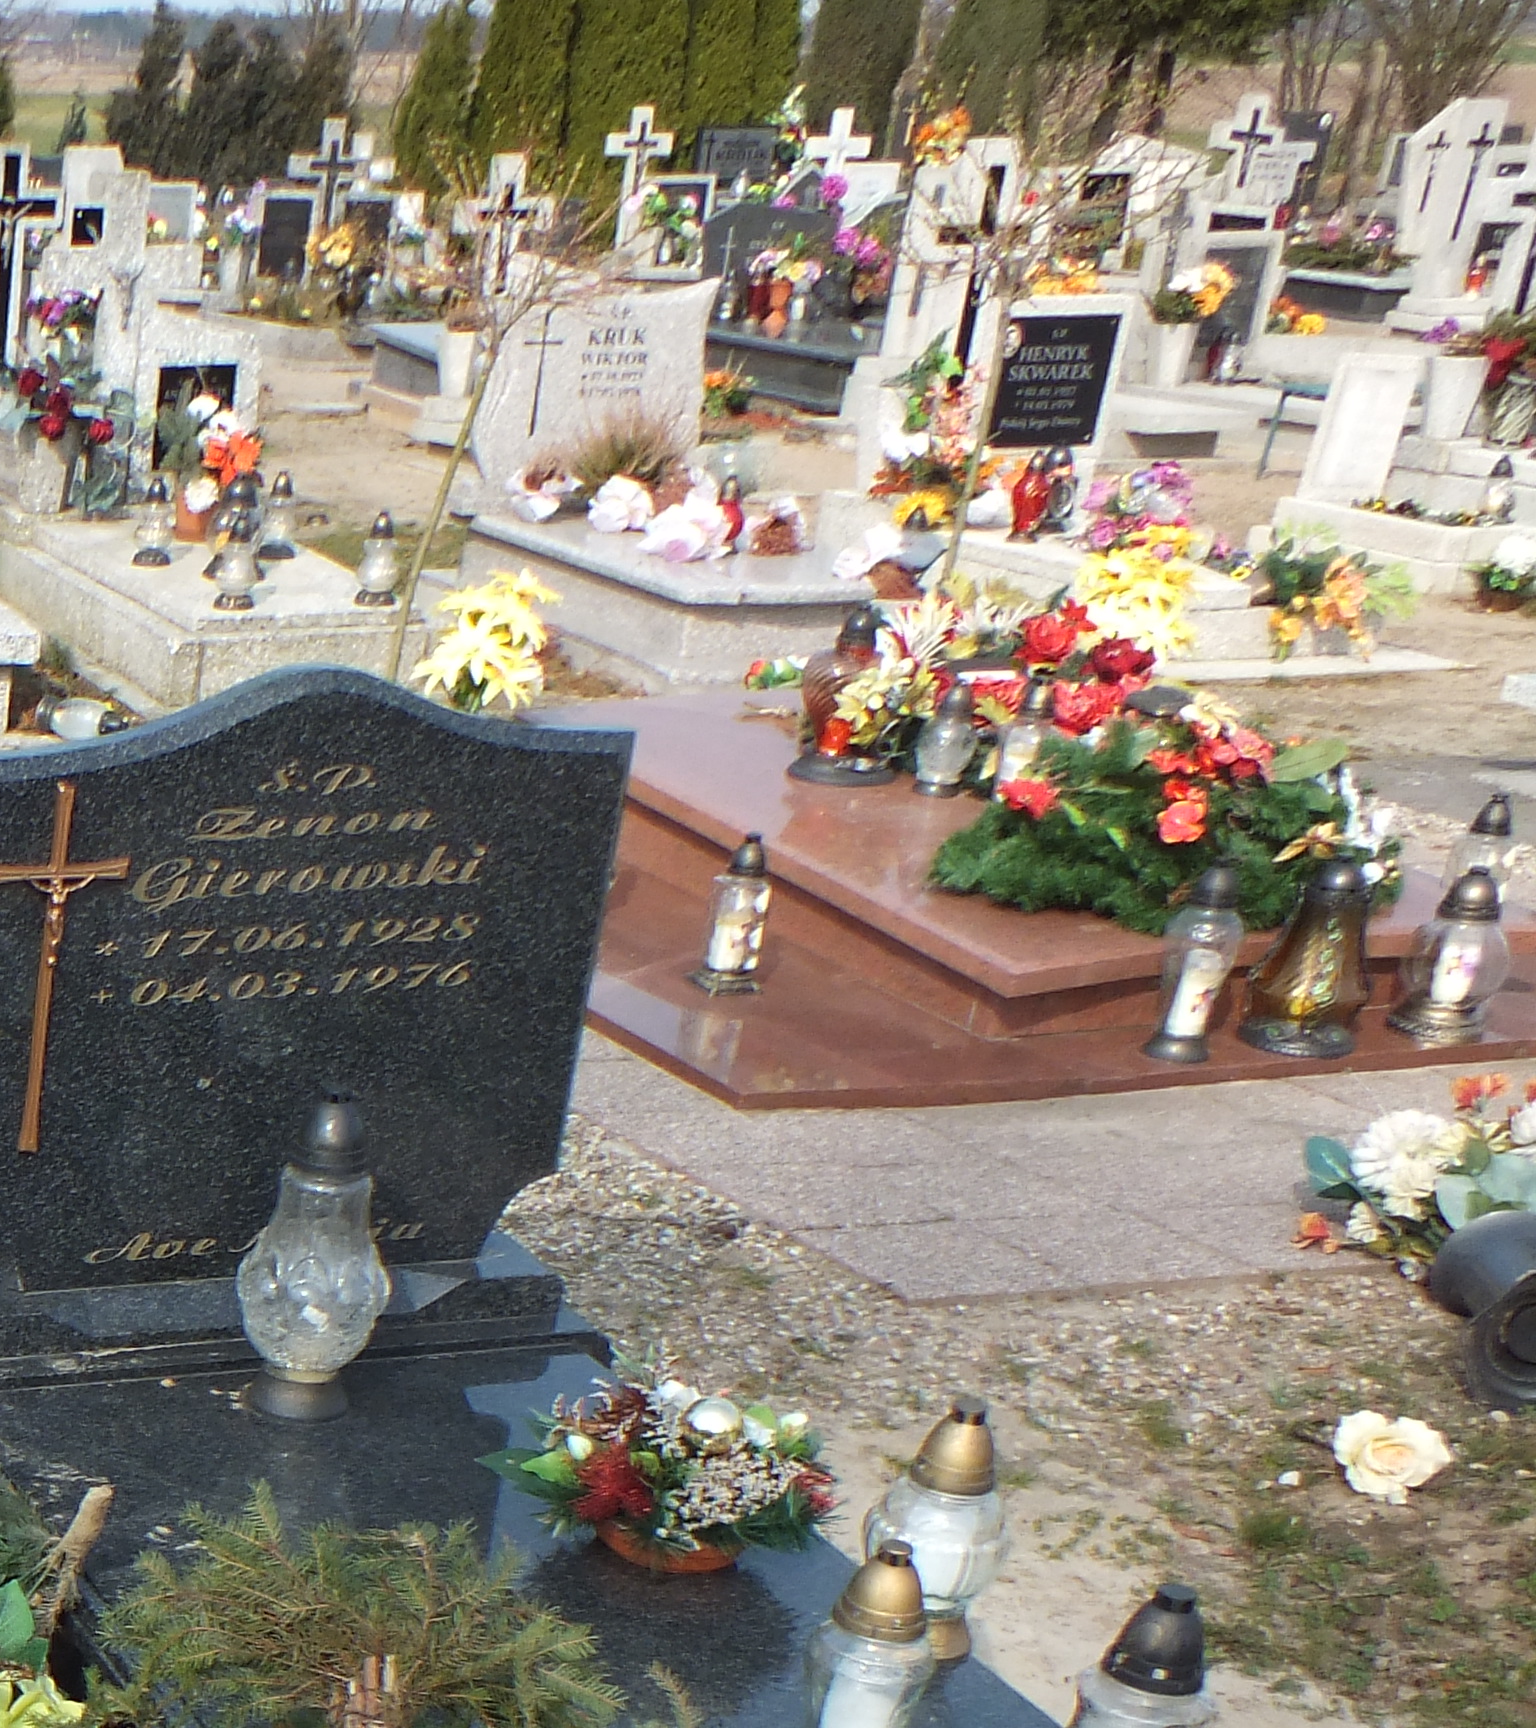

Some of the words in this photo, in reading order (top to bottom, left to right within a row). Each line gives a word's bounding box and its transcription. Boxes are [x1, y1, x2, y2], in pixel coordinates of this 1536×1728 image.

[1019, 343, 1091, 362] HENRYK
[1007, 362, 1095, 382] SKWAREK
[183, 806, 438, 843] Zenon
[127, 843, 490, 914] Gierowski
[142, 911, 484, 960] 17.06.1928
[130, 957, 473, 1009] 04.03.1976
[82, 1230, 218, 1265] Ave
